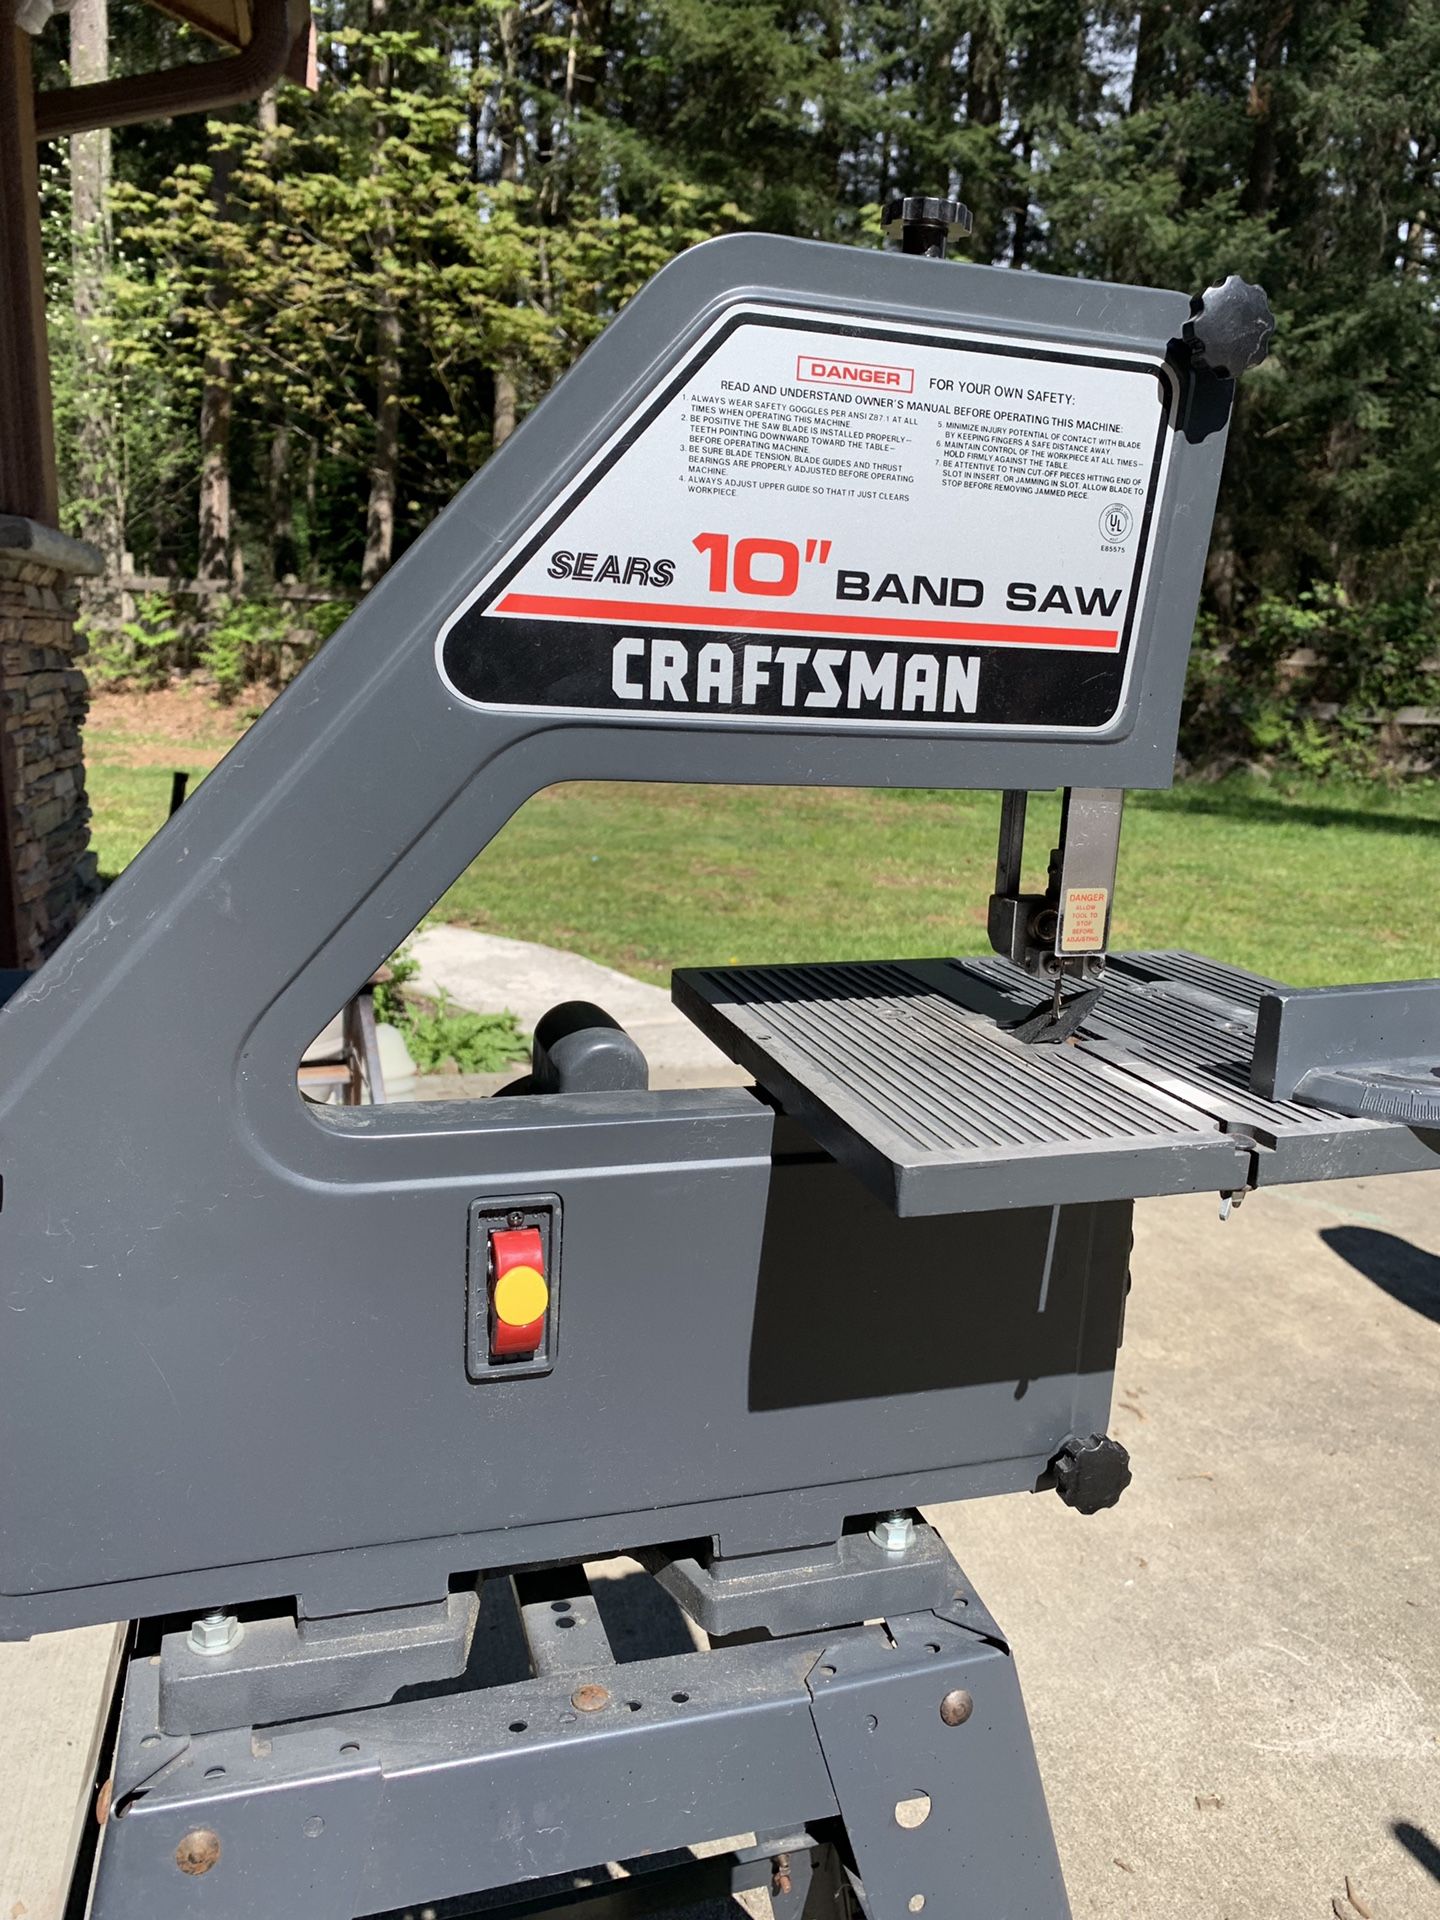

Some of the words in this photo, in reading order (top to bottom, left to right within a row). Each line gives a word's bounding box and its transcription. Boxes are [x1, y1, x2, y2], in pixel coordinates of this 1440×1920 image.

[811, 363, 900, 385] DANGER
[929, 377, 954, 391] FOR
[958, 381, 991, 395] YOUR
[994, 385, 1023, 399] OWN
[1026, 389, 1075, 405] SAFETY:
[691, 394, 725, 405] ALWAYS
[728, 398, 753, 407] WEAR
[754, 401, 786, 410] SAFETY
[788, 404, 828, 416] GOGGLES
[830, 409, 846, 417] PER
[847, 411, 867, 419] ANSI
[903, 417, 918, 425] ALL
[691, 404, 716, 414] TIMES
[718, 407, 743, 416] WHEN
[745, 410, 791, 422] OPERATING
[794, 415, 812, 424] THIS
[720, 380, 750, 392] READ
[752, 384, 777, 395] AND
[779, 387, 852, 403] UNDERSTAND
[854, 394, 904, 409] OWNER'S
[906, 400, 951, 414] MANUAL
[953, 406, 991, 419] BEFORE
[993, 410, 1049, 425] OPERATING
[1051, 416, 1073, 428] THIS
[1075, 419, 1123, 433] MACHINE:
[689, 414, 700, 422] BE
[702, 416, 741, 427] POSITIVE
[743, 420, 759, 428] THE
[761, 421, 780, 430] SAW
[782, 423, 808, 433] BLADE
[810, 426, 818, 434] IS
[820, 428, 864, 439] INSTALLED
[690, 424, 717, 434] TEETH
[719, 427, 758, 438] POINTING
[759, 431, 809, 443] DOWNWARD
[811, 436, 845, 447] TOWARD
[847, 440, 862, 449] THE
[945, 421, 979, 432] MINIMIZE
[980, 425, 1007, 434] INJURY
[1008, 428, 1048, 439] POTENTIAL
[1050, 432, 1060, 440] OF
[1061, 434, 1096, 444] CONTACT
[1098, 438, 1116, 446] WITH
[1117, 440, 1141, 449] BLADE
[689, 435, 721, 445] BEFORE
[723, 438, 770, 449] OPERATING
[944, 440, 980, 450] MAINTAIN
[981, 444, 1017, 455] CONTROL
[1031, 449, 1045, 458] THE
[1046, 451, 1089, 462] WORKPIECE
[1101, 457, 1114, 465] ALL
[957, 432, 989, 442] KEEPING
[991, 435, 1023, 446] FINGERS
[1031, 440, 1050, 449] SAFE
[1052, 442, 1088, 453] DISTANCE
[688, 445, 699, 453] BE
[702, 446, 723, 455] SURE
[725, 448, 752, 458] BLADE
[794, 454, 820, 464] BLADE
[822, 457, 851, 467] GUIDES
[853, 461, 870, 469] AND
[872, 462, 902, 471] THRUST
[688, 455, 730, 466] BEARINGS
[732, 459, 748, 467] ARE
[750, 461, 792, 471] PROPERLY
[794, 465, 836, 476] ADJUSTED
[838, 469, 868, 479] BEFORE
[870, 472, 914, 483] OPERATING
[943, 450, 965, 458] HOLD
[966, 452, 993, 461] FIRMLY
[994, 455, 1027, 465] AGAINST
[1029, 458, 1043, 467] THE
[942, 459, 952, 467] BE
[954, 461, 994, 471] ATTENTIVE
[997, 464, 1007, 473] TO
[1009, 466, 1026, 474] THIN
[1059, 471, 1085, 480] PIECES
[1086, 474, 1115, 483] HITTING
[1116, 476, 1131, 485] END
[942, 469, 962, 477] SLOT
[1015, 476, 1049, 486] JAMMING
[1082, 483, 1108, 491] ALLOW
[1108, 485, 1132, 494] BLADE
[1134, 487, 1144, 495] TO
[688, 475, 722, 485] ALWAYS
[724, 478, 756, 488] ADJUST
[759, 482, 785, 490] UPPER
[786, 484, 810, 493] GUIDE
[812, 486, 824, 494] SO
[826, 487, 846, 496] THAT
[878, 492, 909, 502] CLEARS
[942, 479, 962, 487] STOP
[963, 481, 992, 490] BEFORE
[994, 483, 1033, 494] REMOVING
[1034, 487, 1066, 497] JAMMED
[1110, 514, 1121, 531] UL
[547, 550, 676, 587] SEARS
[836, 570, 984, 608] BAND
[1006, 582, 1122, 616] SAW
[612, 637, 981, 714] CRAFTSMAN
